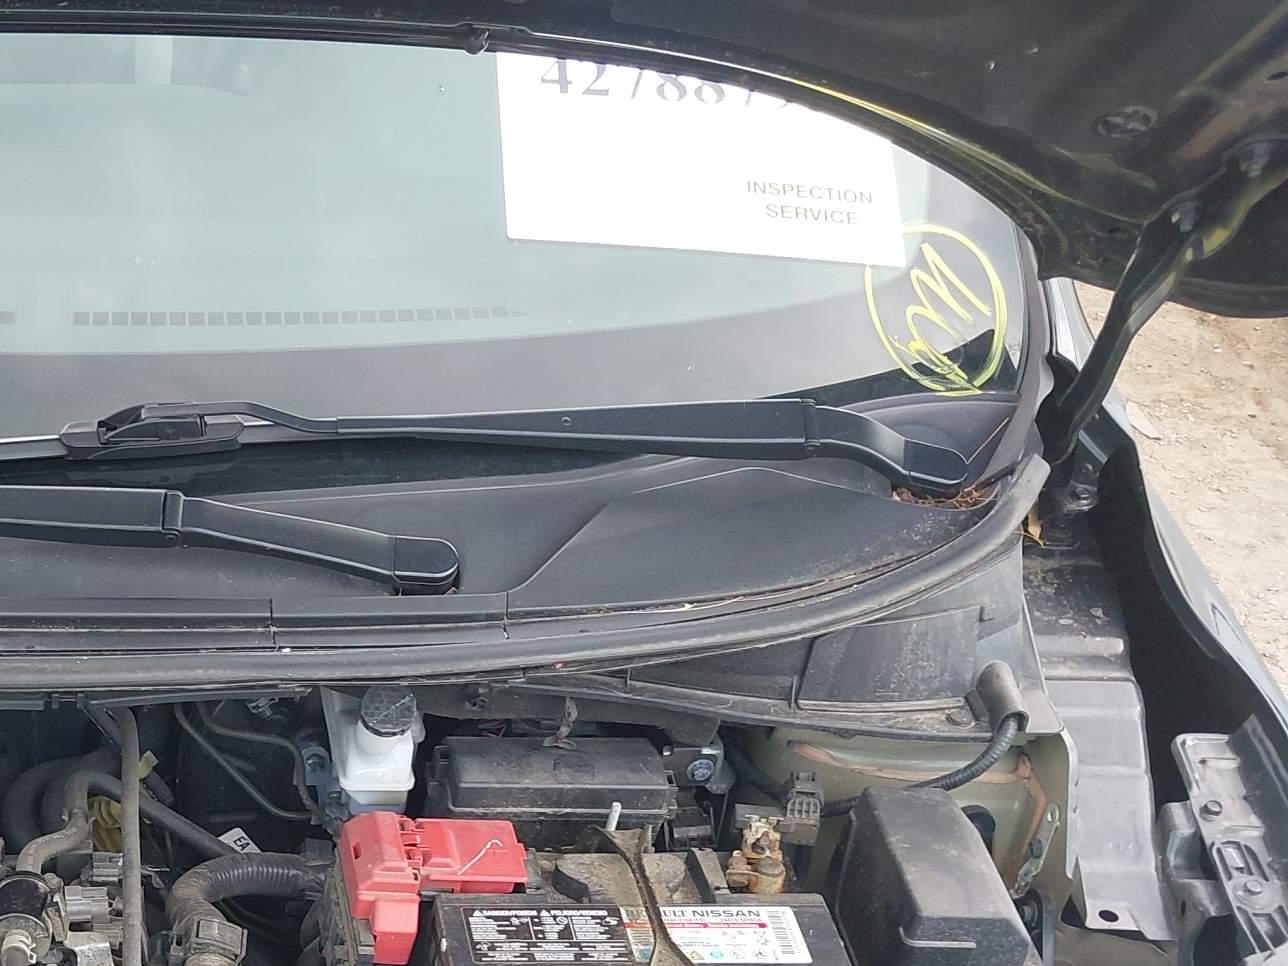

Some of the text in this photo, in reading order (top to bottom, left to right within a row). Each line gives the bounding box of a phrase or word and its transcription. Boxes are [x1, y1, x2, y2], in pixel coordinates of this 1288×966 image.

[746, 180, 873, 204] INSPECTION
[765, 203, 858, 224] SERVICE
[691, 909, 761, 918] NISSAN
